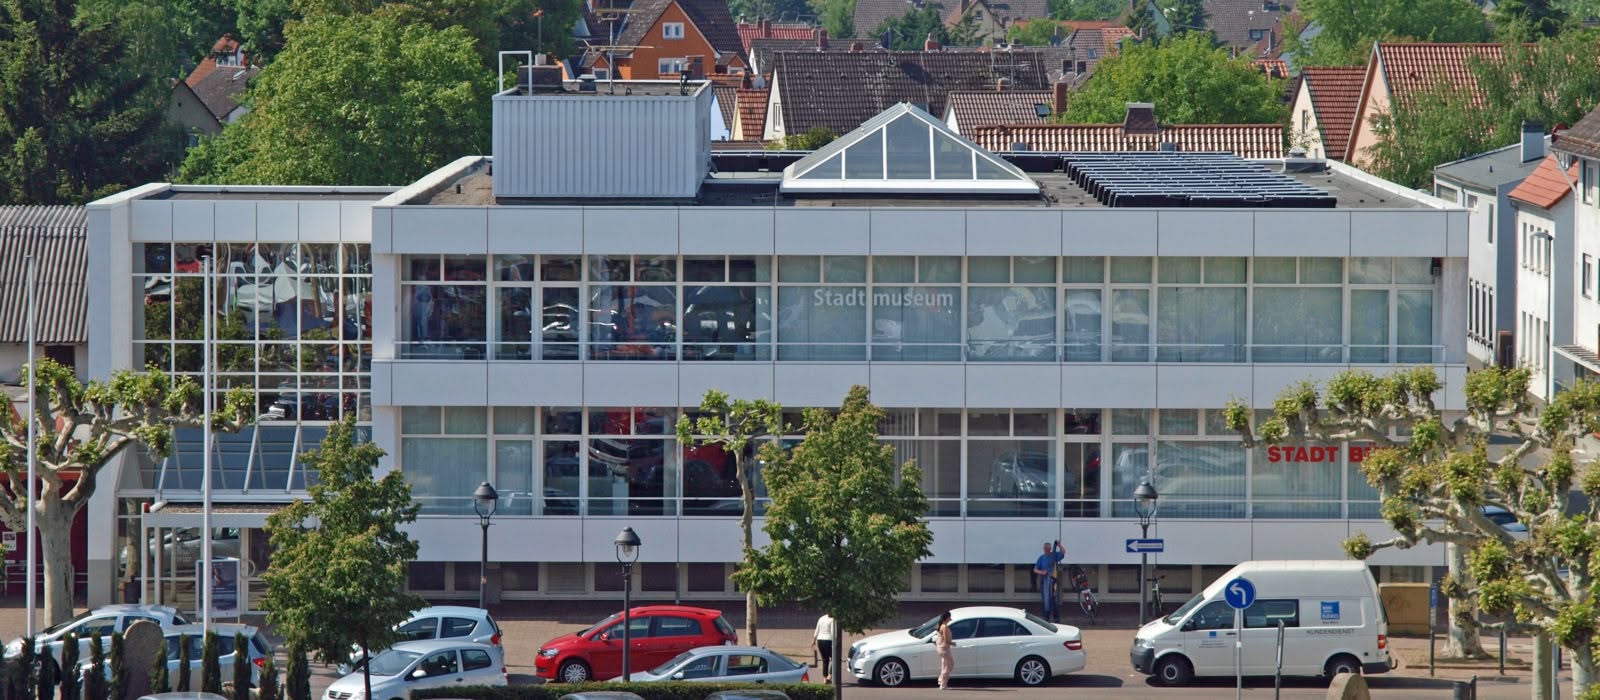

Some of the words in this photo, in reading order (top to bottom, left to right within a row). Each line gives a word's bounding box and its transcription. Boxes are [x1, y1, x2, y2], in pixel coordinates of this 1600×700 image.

[813, 288, 866, 307] Stadt
[873, 291, 953, 307] museum
[1267, 446, 1338, 463] STADT
